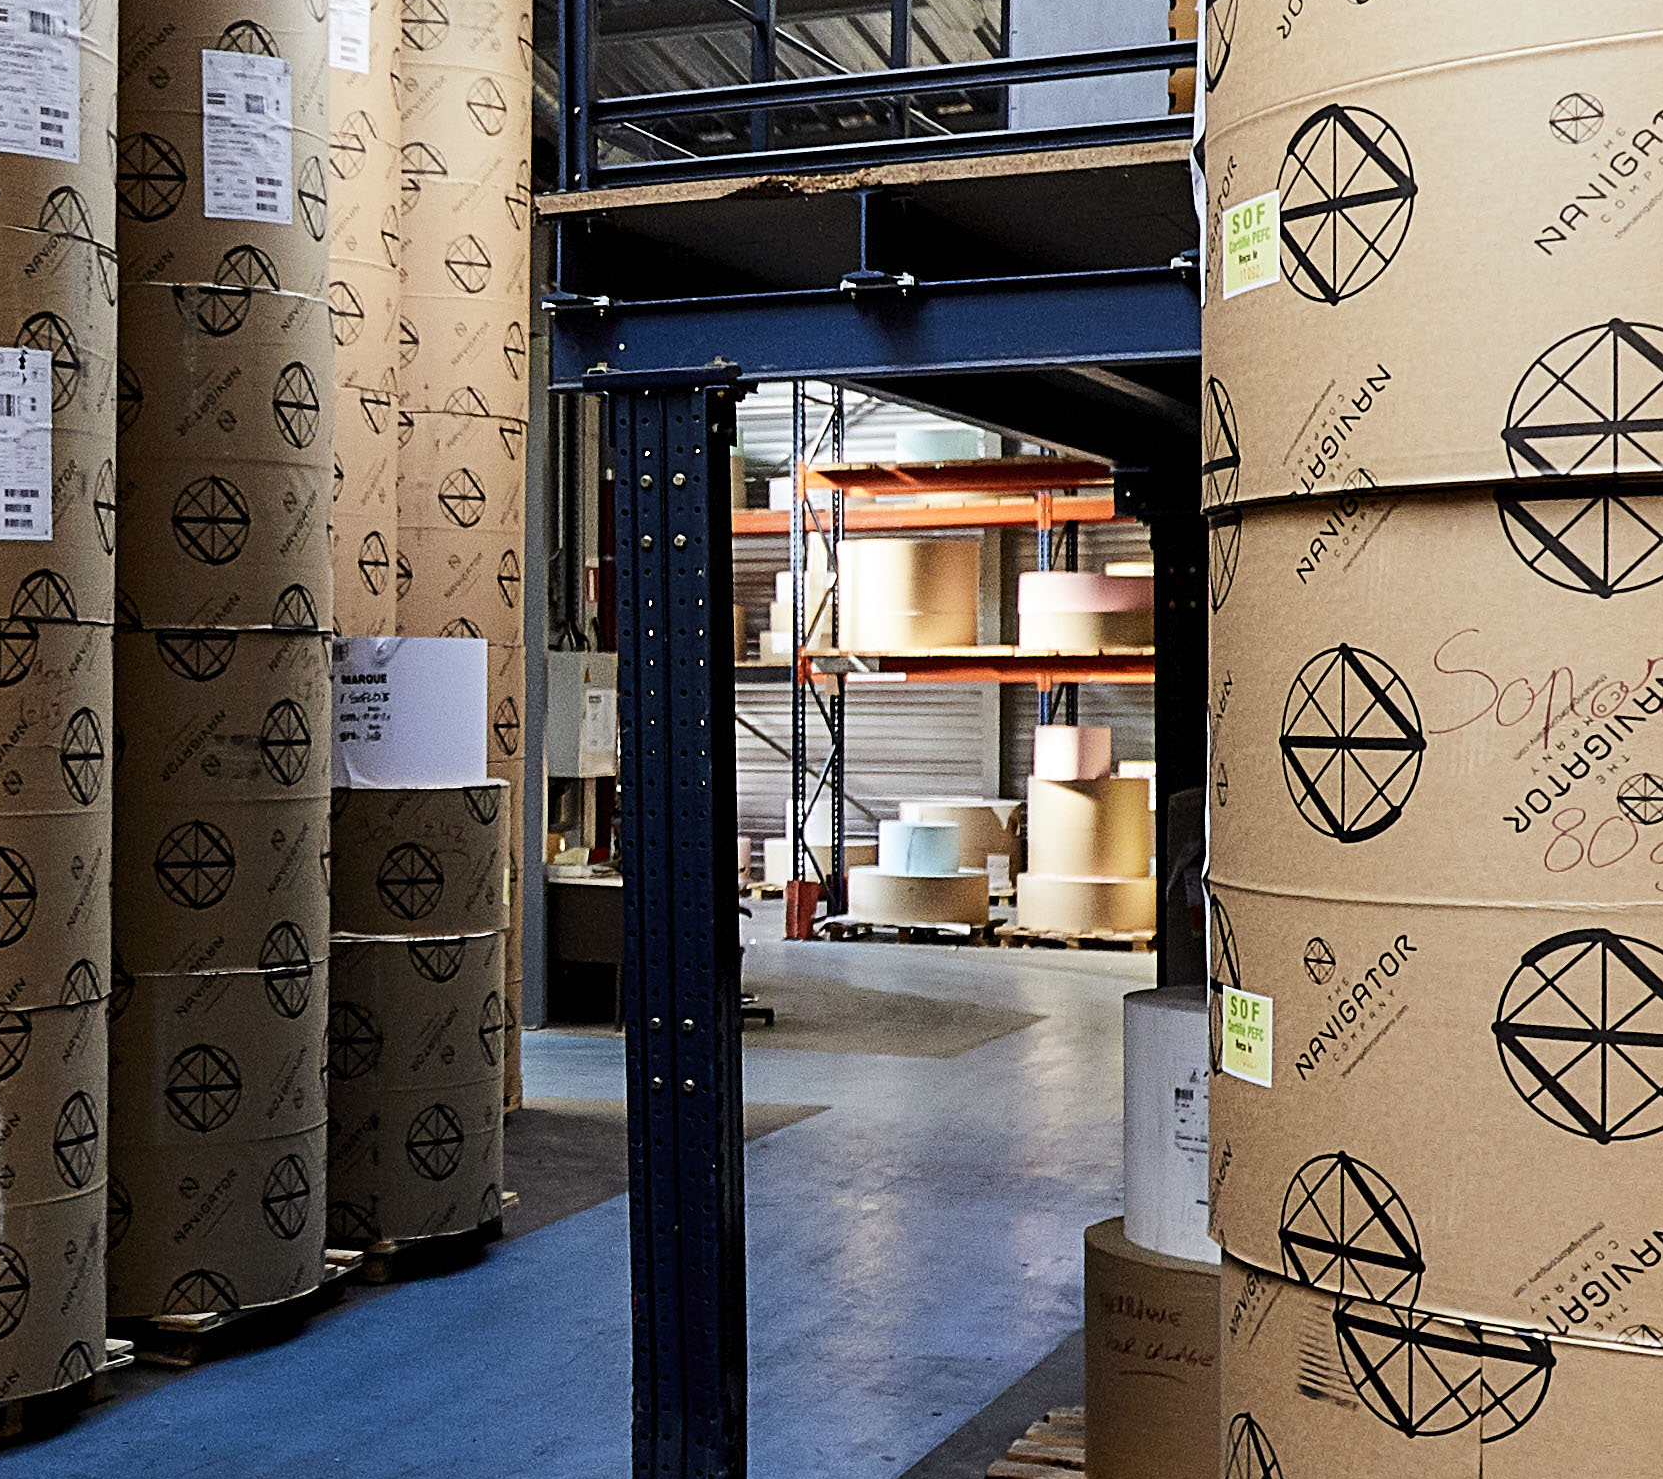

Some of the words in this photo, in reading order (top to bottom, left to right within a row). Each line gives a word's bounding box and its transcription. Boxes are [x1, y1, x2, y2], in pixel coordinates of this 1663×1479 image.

[1592, 126, 1629, 160] THE
[1232, 204, 1266, 236] SOF
[341, 674, 388, 684] MARQUE
[1230, 996, 1260, 1022] SOF
[1296, 933, 1418, 1081] NAVIGATOR
[1247, 1025, 1264, 1042] PEFC
